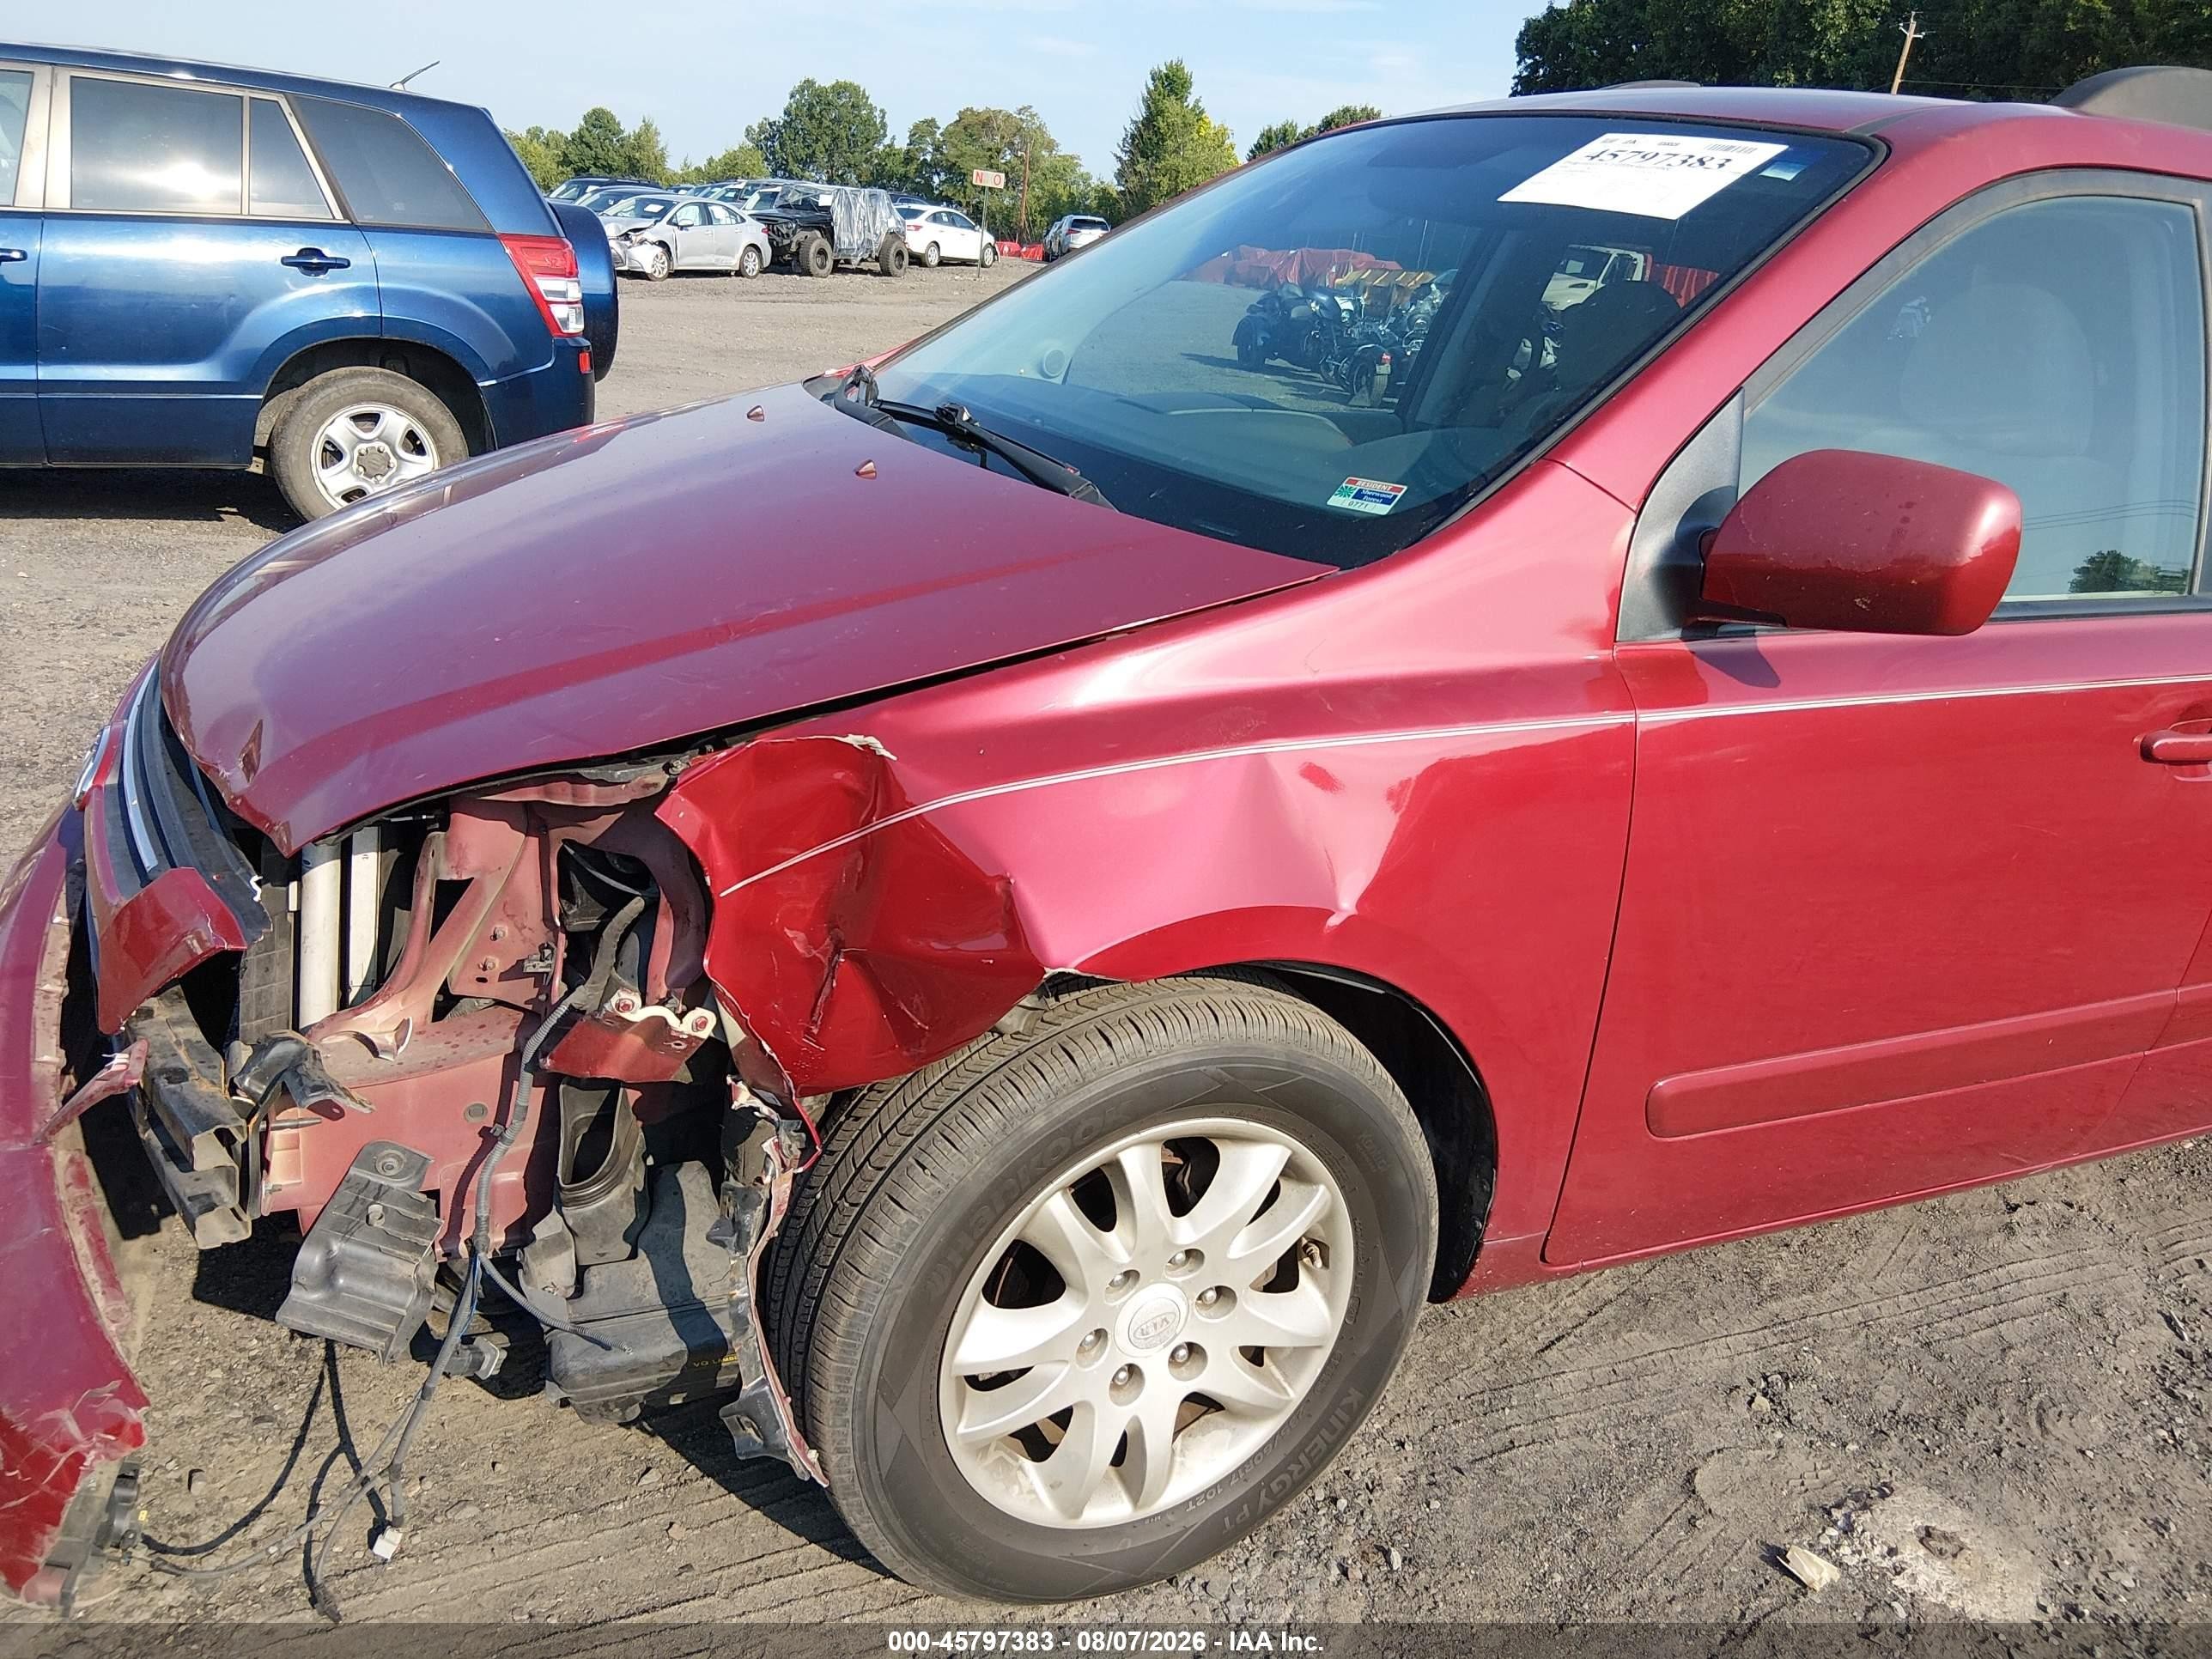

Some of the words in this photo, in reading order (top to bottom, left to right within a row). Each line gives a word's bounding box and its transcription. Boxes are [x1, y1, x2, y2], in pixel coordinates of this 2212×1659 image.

[1585, 149, 1732, 170] 45797383
[1356, 481, 1393, 491] RESIDENT
[1230, 1407, 1306, 1486] 235/60R17
[1253, 1388, 1364, 1516] KINERGY
[1185, 1485, 1224, 1512] 102T
